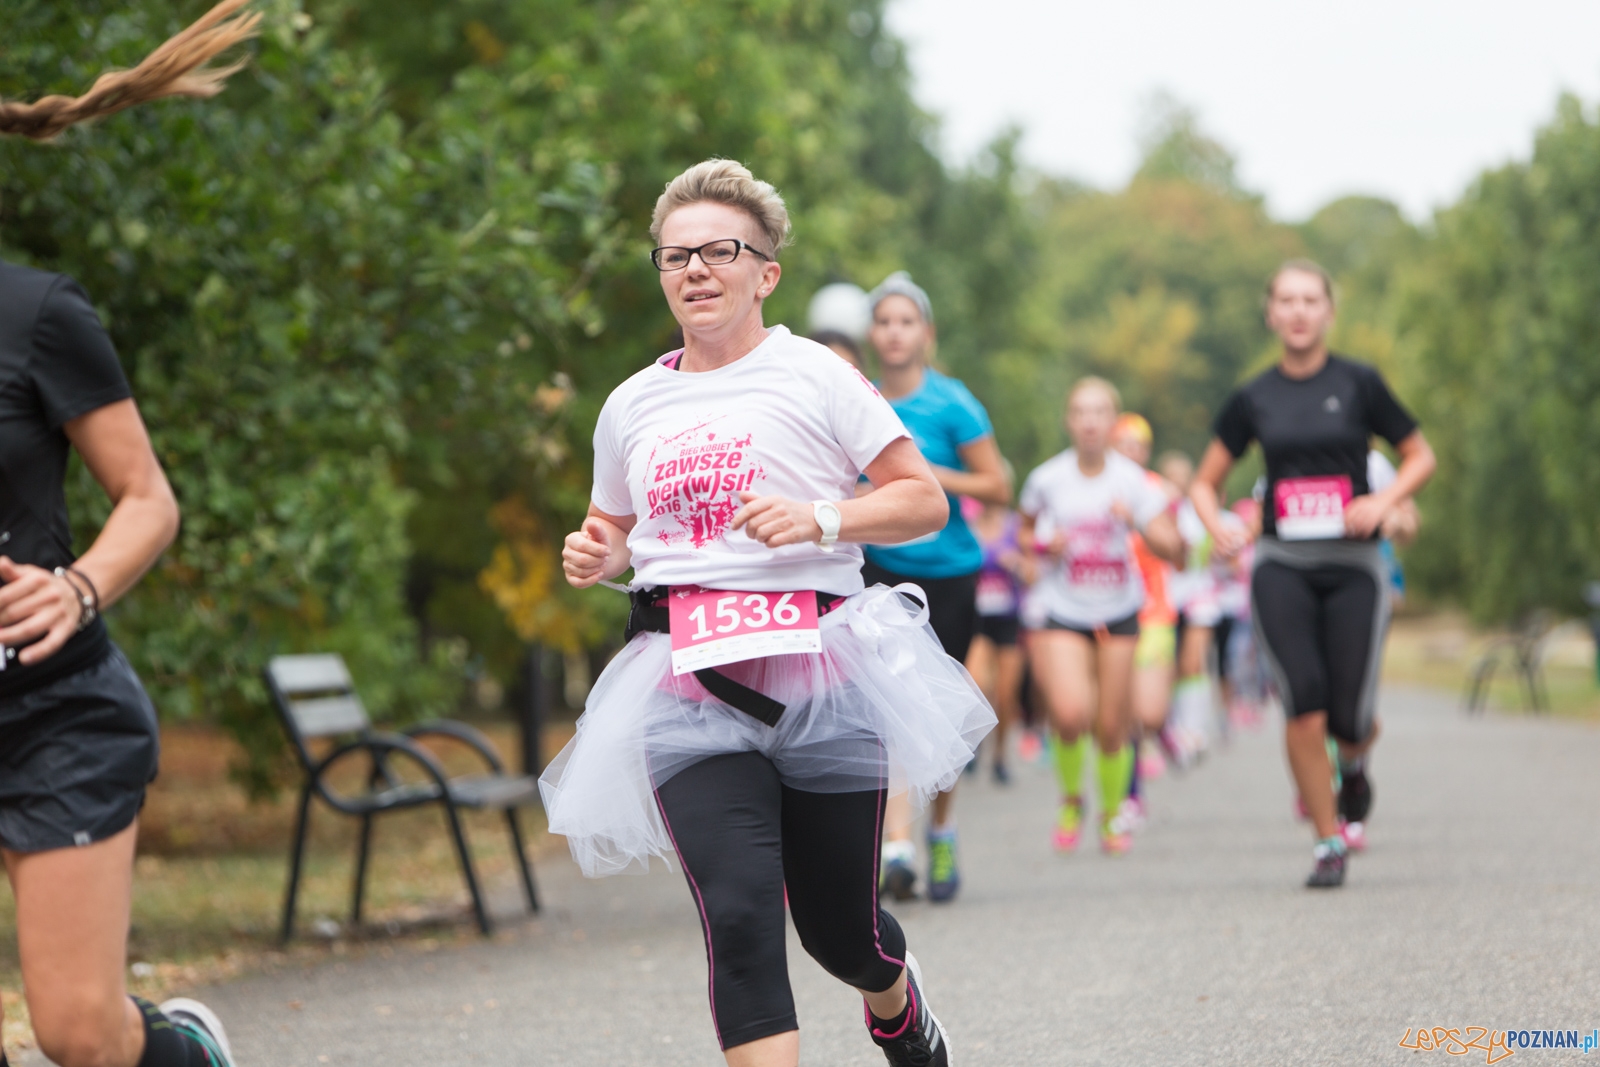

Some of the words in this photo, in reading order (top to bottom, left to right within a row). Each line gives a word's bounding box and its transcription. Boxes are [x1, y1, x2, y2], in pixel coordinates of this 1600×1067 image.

[680, 446, 699, 457] BIEG
[700, 442, 732, 454] KOBIET
[654, 450, 743, 483] zawsze
[648, 498, 682, 520] 2016
[687, 592, 801, 642] 1536
